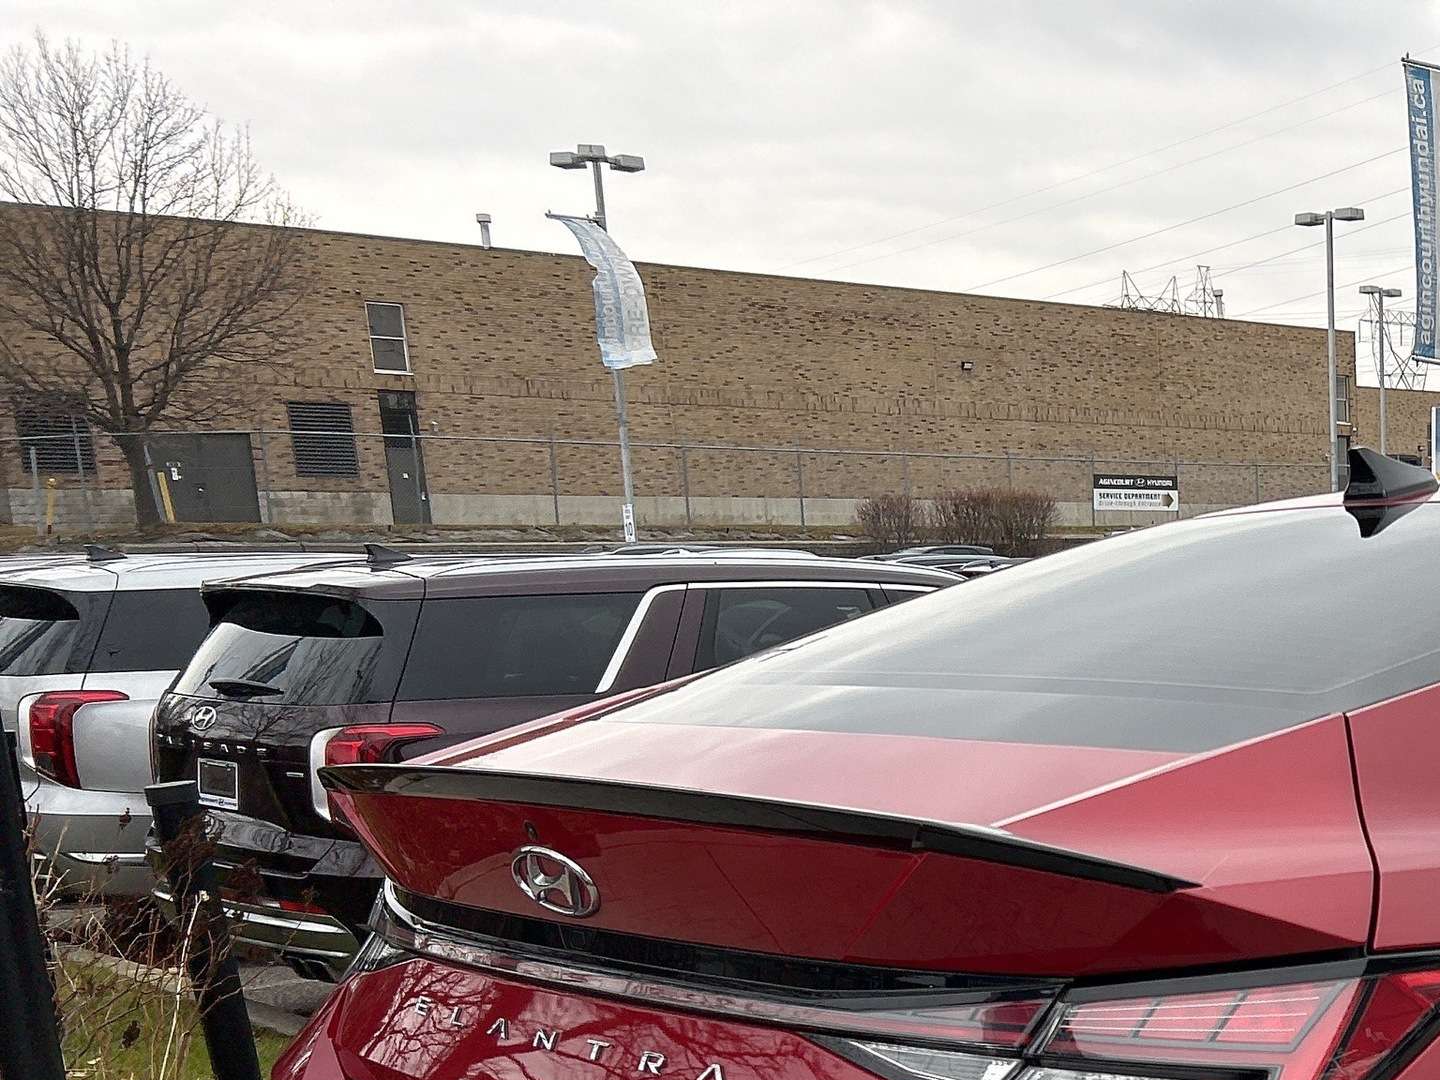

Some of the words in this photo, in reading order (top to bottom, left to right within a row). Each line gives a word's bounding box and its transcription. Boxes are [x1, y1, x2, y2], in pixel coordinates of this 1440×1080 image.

[1411, 79, 1434, 345] agincourthyundai.ca
[1098, 478, 1133, 486] AGINCOURT
[1147, 479, 1173, 487] HYUNDAI
[1098, 492, 1122, 500] SERVICE
[1123, 492, 1161, 500] DEPARTMENT
